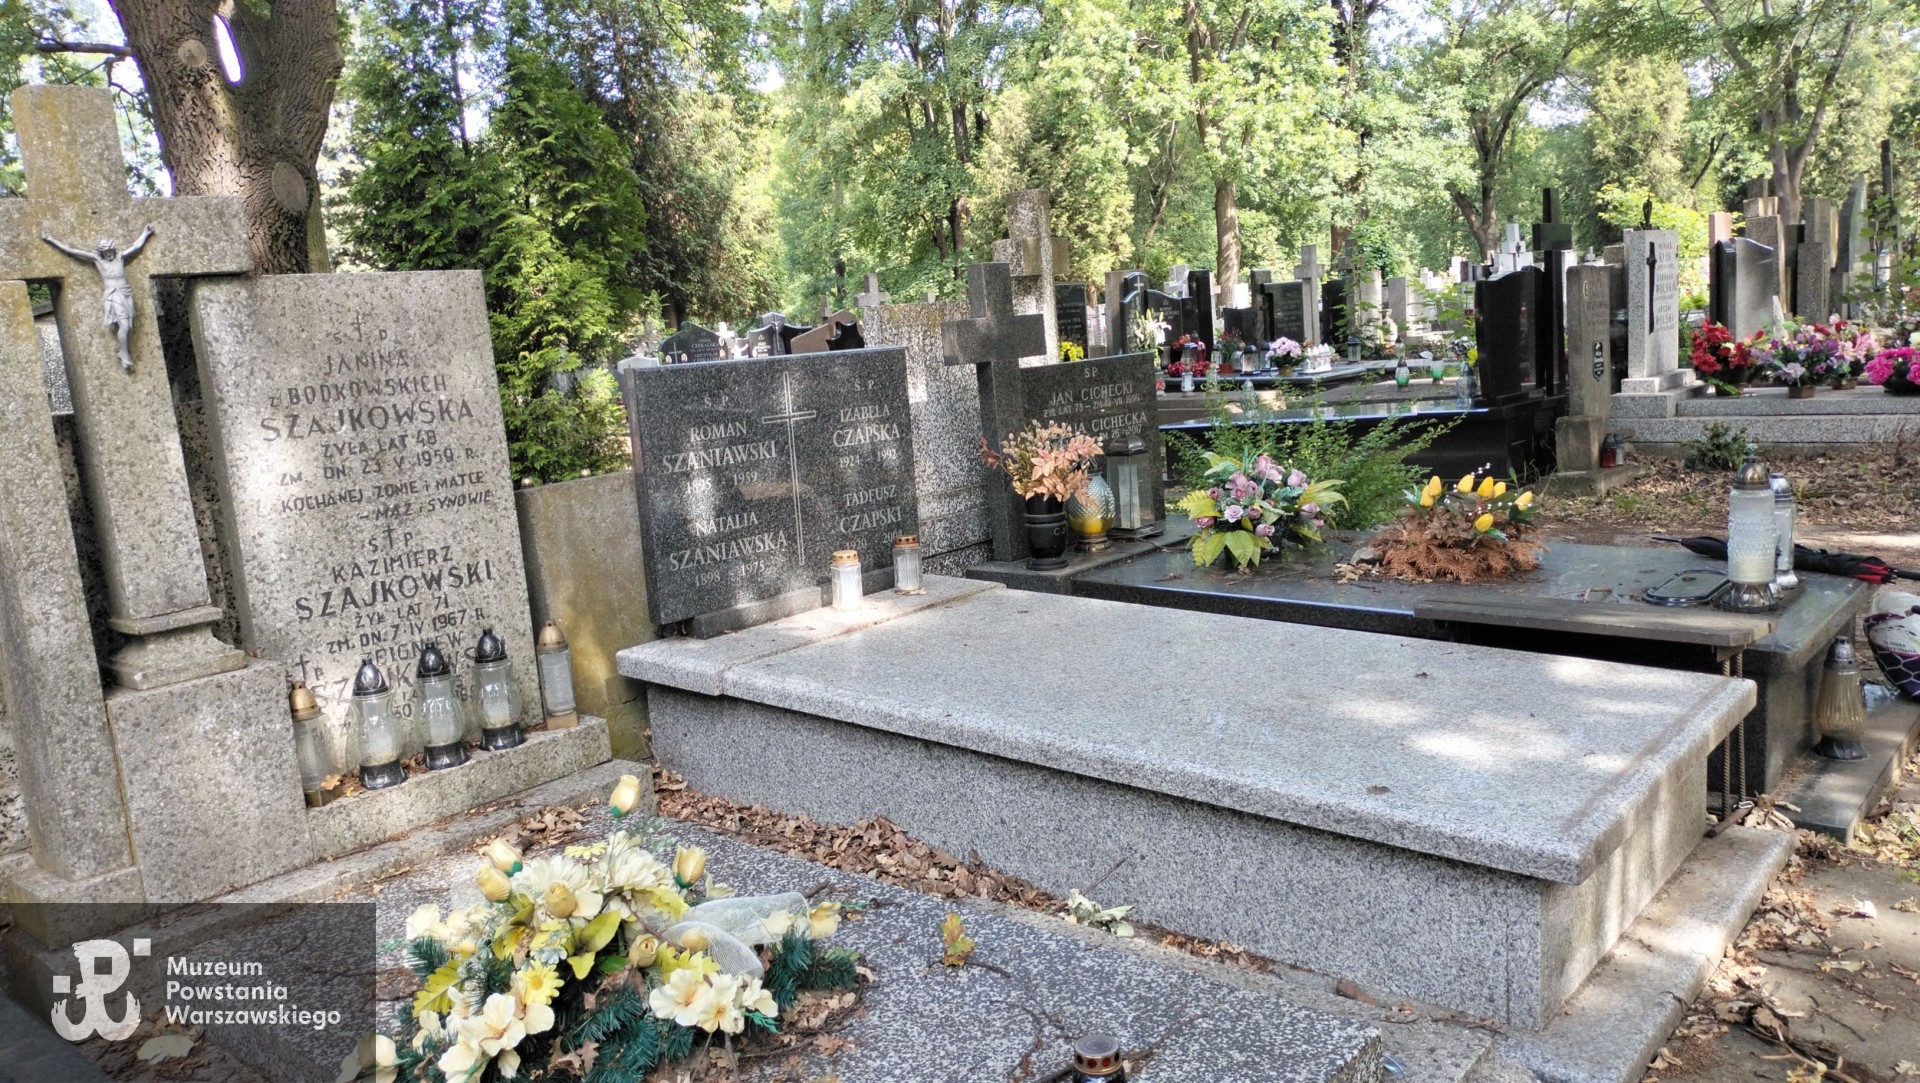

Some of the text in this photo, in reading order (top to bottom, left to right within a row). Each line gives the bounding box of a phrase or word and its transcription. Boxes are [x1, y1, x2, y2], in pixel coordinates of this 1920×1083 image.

[324, 352, 410, 376] JANINA
[288, 374, 447, 406] BODKOWSKICH
[1049, 381, 1133, 406] JAN CICHECKI
[260, 398, 474, 442] SZAJKOWSKA
[840, 403, 890, 423] IZABELA
[1058, 405, 1072, 416] LAT
[1091, 411, 1147, 432] CICHECKA
[377, 434, 409, 452] LAT
[416, 429, 437, 447] 48
[689, 420, 747, 442] ROMAN
[833, 422, 900, 448] CZAPSKA
[662, 440, 777, 474] SZANIAWSKI
[840, 448, 897, 468] 1924 1992
[281, 488, 364, 513] KOCHANEJ
[435, 471, 484, 491] MATCE
[686, 471, 758, 494] 1895 1959
[427, 489, 492, 512] SYNOWIE
[843, 484, 897, 507] TADEUSZ
[695, 511, 759, 537] NATALIA
[840, 505, 903, 534] CZAPSKI
[669, 530, 788, 571] SZANIAWSKA
[332, 545, 454, 584] KAZIMIERZ
[695, 560, 765, 587] 1898 1975
[295, 559, 492, 620] SZAJKOWSKI
[397, 602, 424, 620] LAT
